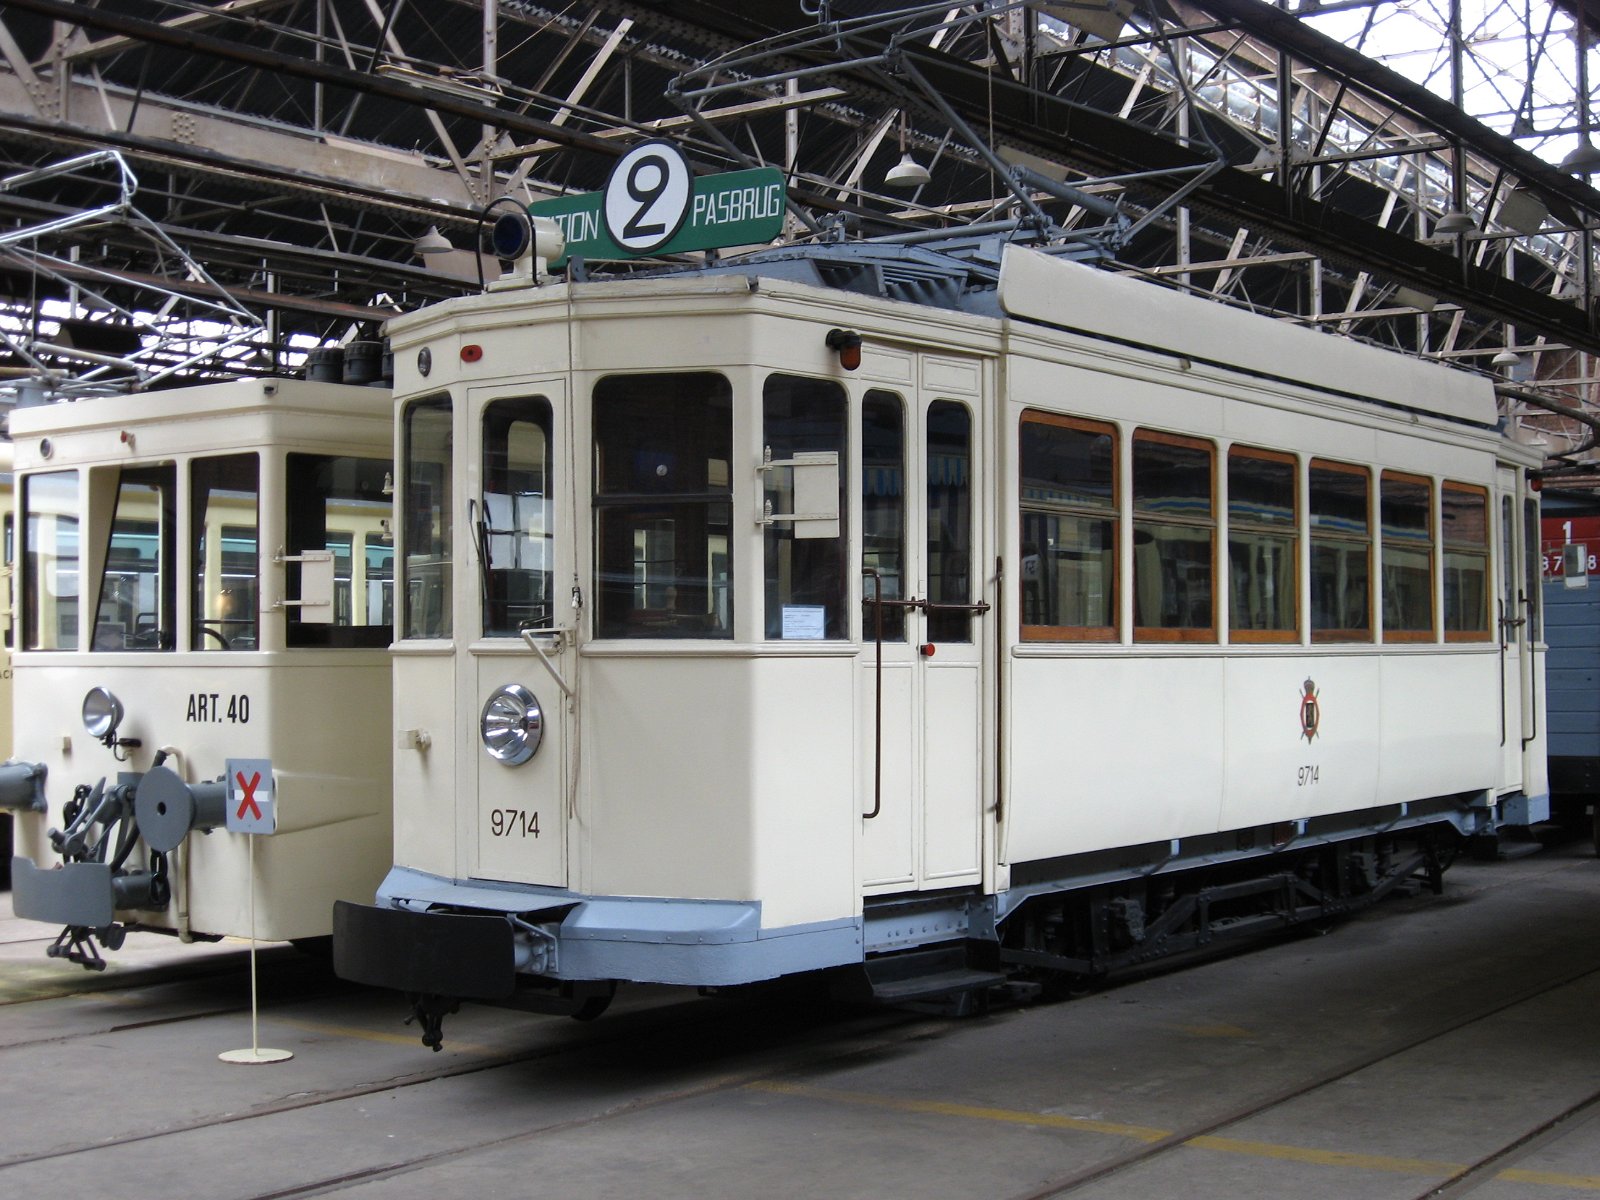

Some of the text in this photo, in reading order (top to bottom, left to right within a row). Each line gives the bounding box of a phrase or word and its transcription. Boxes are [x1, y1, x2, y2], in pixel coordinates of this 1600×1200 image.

[552, 154, 781, 243] TION 2 PASBRUG
[187, 693, 250, 724] ART. 40
[1297, 766, 1319, 786] 9714
[491, 809, 540, 839] 9714
